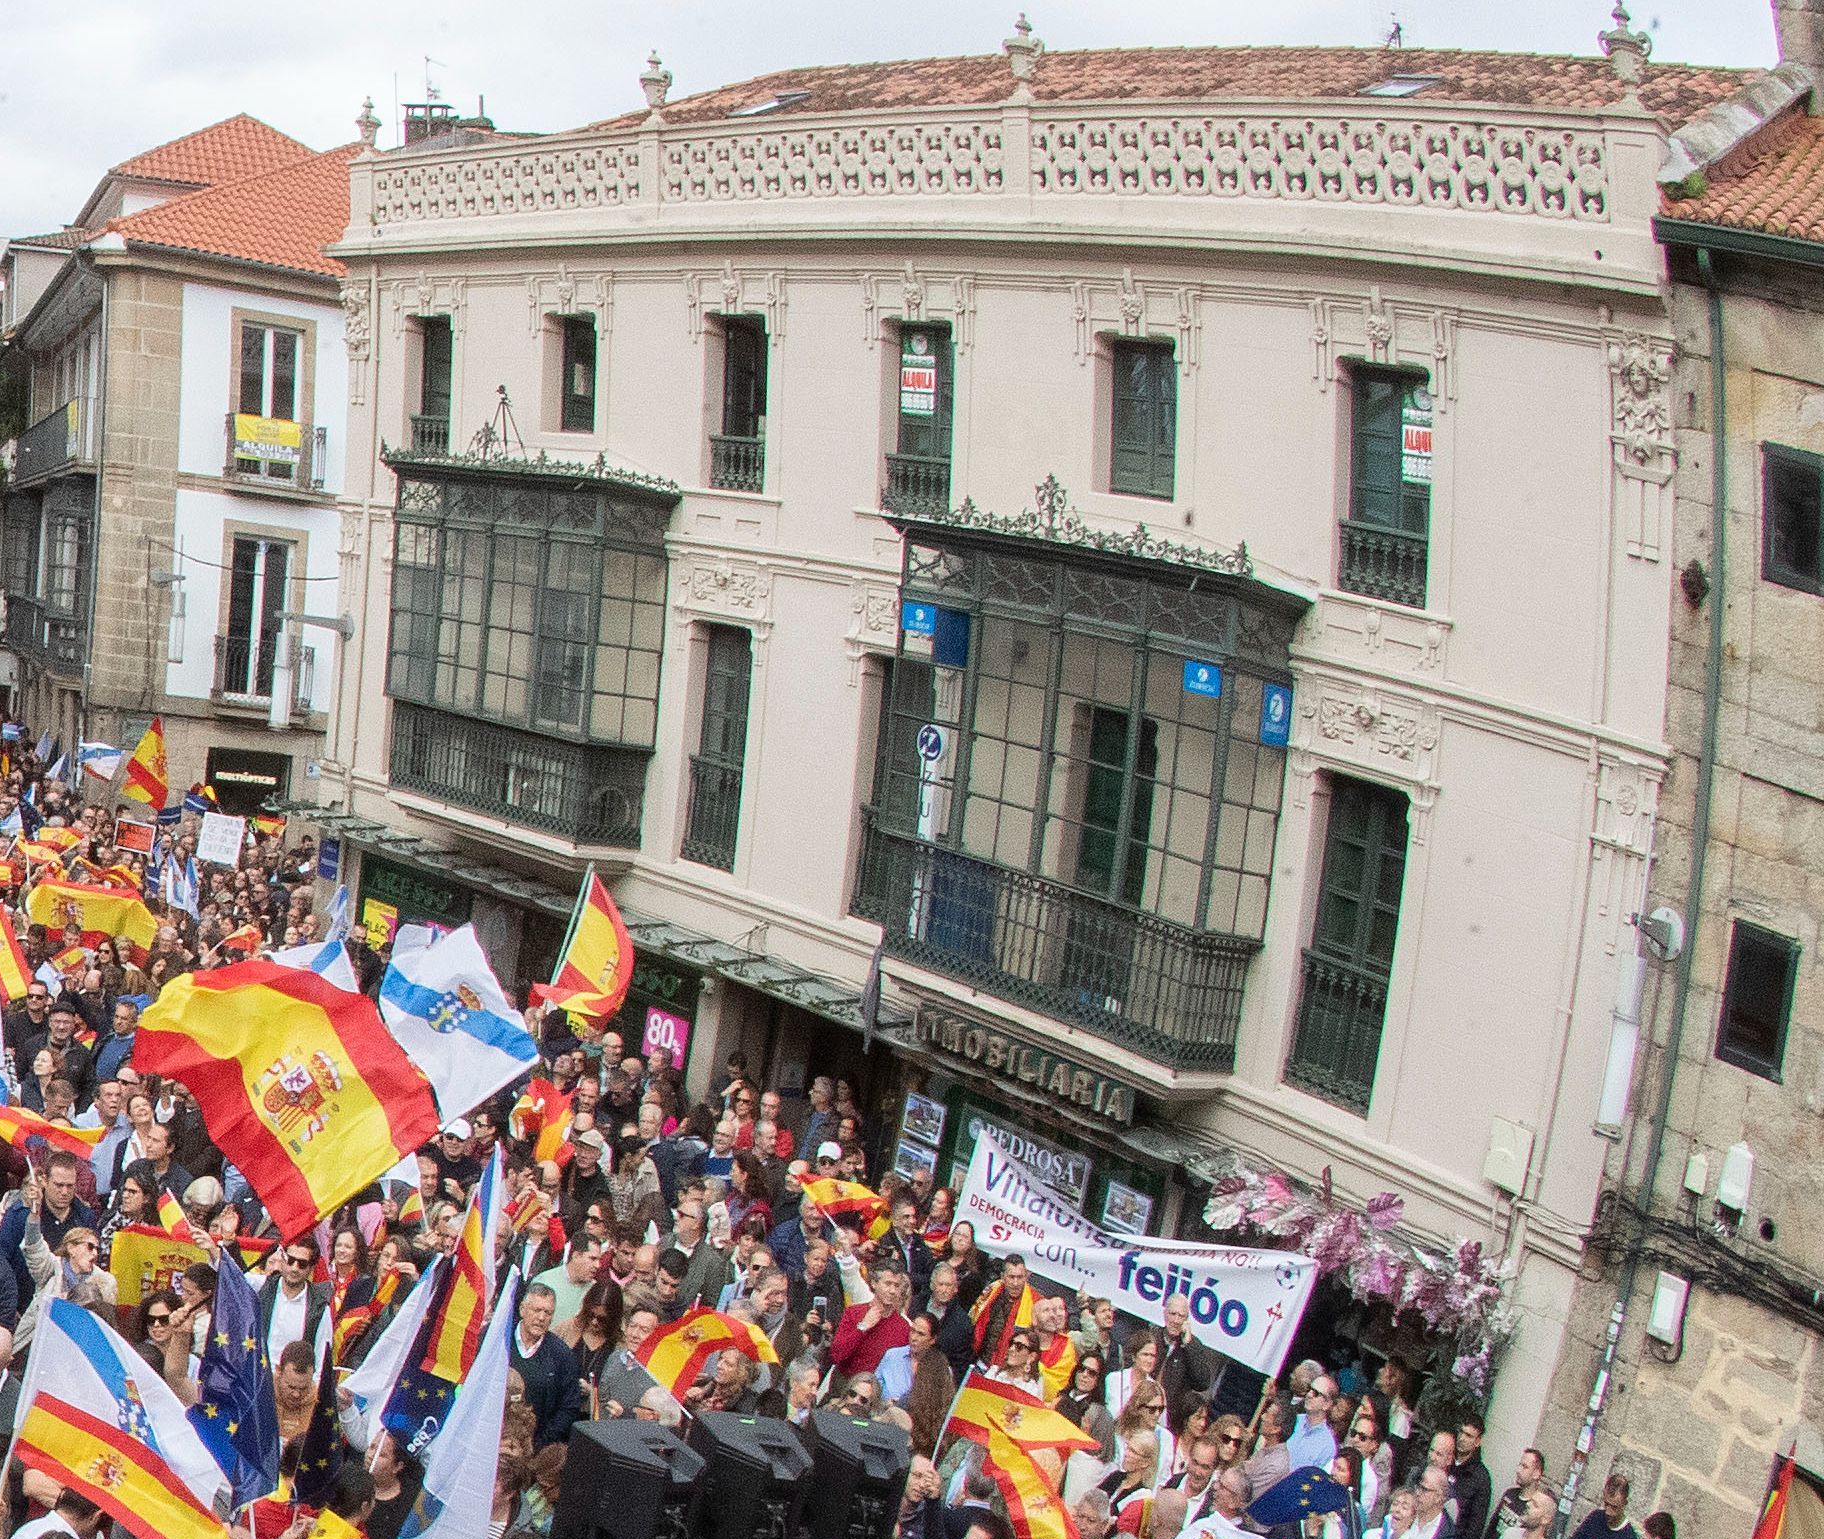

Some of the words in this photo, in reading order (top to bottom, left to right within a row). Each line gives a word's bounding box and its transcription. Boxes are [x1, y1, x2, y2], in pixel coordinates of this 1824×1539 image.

[985, 1125, 1075, 1187] PEDROSA
[969, 1193, 1046, 1242] DEMOCRACIA
[1117, 1251, 1250, 1338] feijóo
